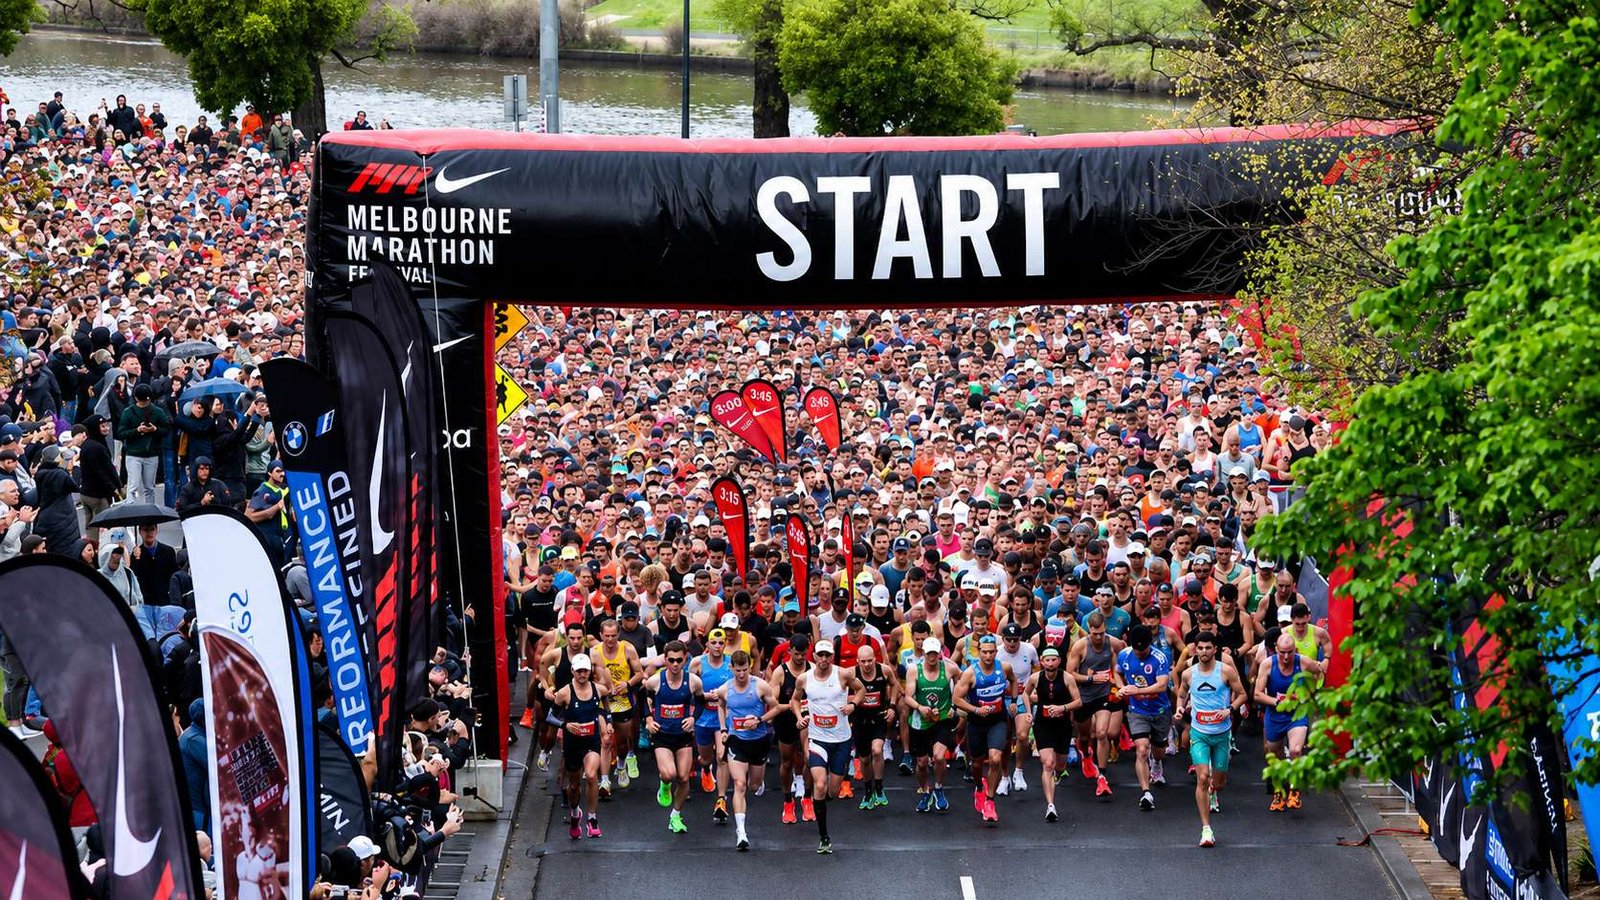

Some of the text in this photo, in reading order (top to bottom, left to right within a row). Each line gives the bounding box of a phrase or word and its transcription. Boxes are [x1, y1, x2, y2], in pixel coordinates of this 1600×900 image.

[347, 204, 512, 234] MELBOURNE
[756, 172, 1060, 282] START
[347, 235, 494, 265] MARATHON
[349, 265, 431, 283] FEVAL
[715, 397, 742, 415] 3:00
[720, 487, 739, 505] 3:15
